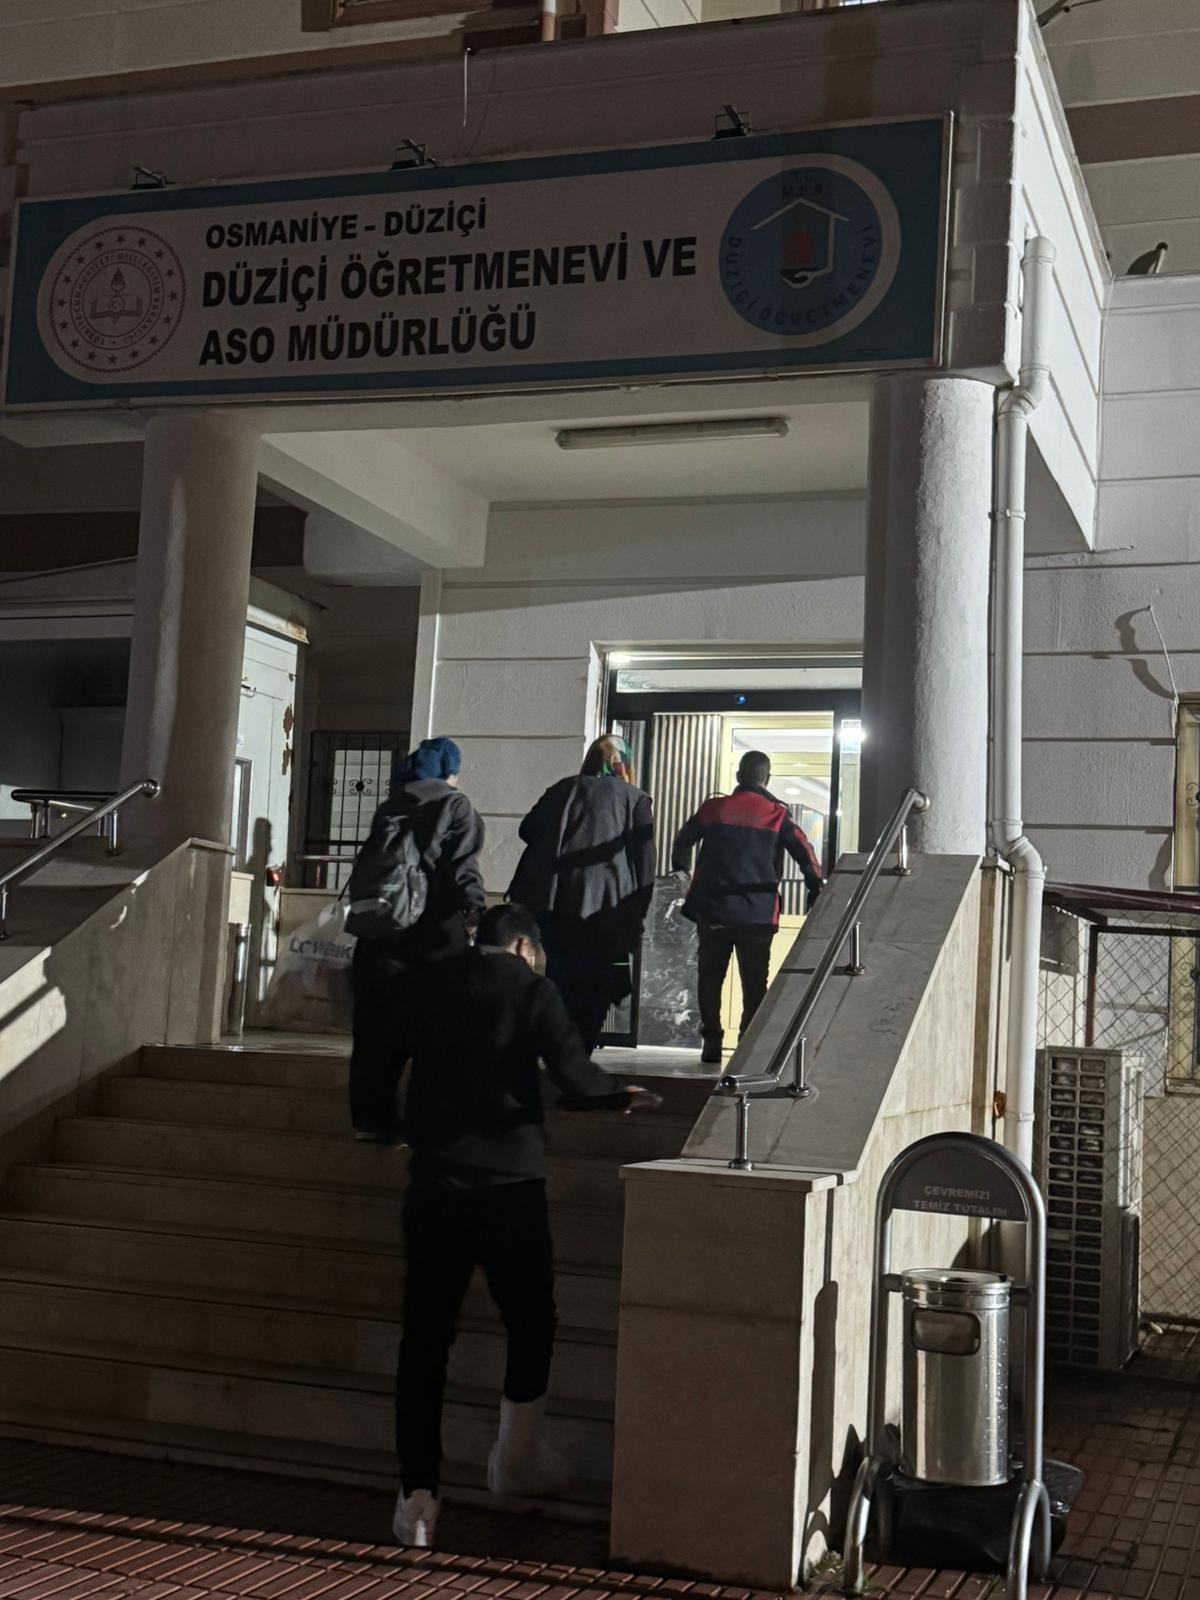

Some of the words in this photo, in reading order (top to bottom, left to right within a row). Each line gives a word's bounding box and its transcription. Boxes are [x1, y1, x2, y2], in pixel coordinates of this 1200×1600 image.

[205, 210, 359, 250] OSMANİYE
[383, 196, 487, 239] DÜZİÇİ
[202, 254, 328, 313] DÜZİÇİ
[340, 231, 628, 300] ÖĞRETMENEVİ
[642, 236, 697, 279] VE
[198, 326, 276, 367] ASO
[287, 302, 537, 363] MÜDÜRLÜĞÜ
[912, 1199, 950, 1212] TEMİZ
[953, 1203, 1008, 1217] TUTALIM
[924, 1185, 991, 1200] ÇEVREMİZİ
